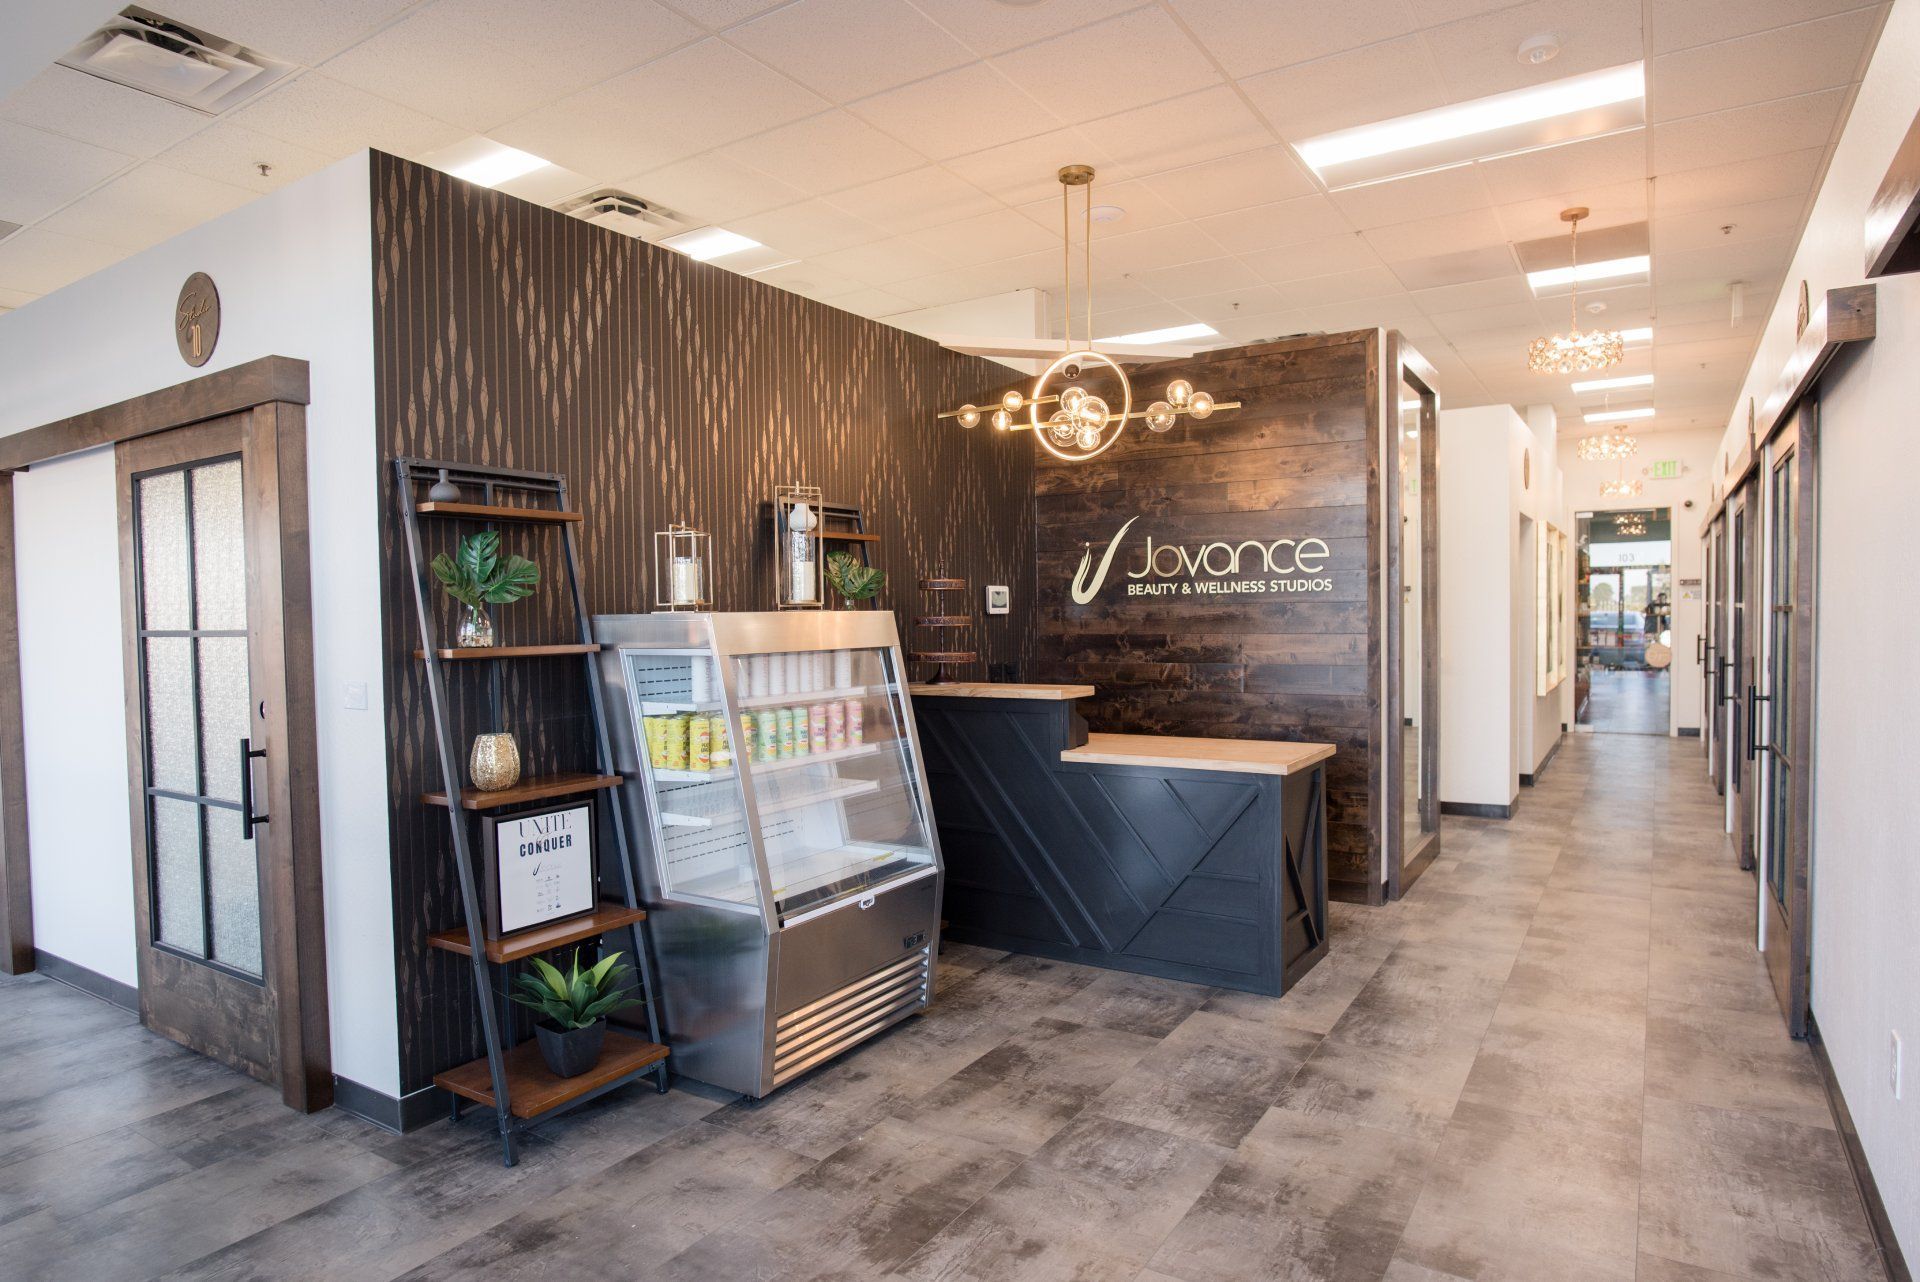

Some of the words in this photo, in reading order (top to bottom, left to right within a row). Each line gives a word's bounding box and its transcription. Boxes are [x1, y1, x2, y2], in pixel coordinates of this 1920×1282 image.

[191, 324, 203, 358] 10
[1653, 460, 1678, 477] EXIT
[1127, 535, 1330, 579] Jovance
[1127, 583, 1178, 596] BEAUTY
[1181, 583, 1192, 595] &
[1194, 580, 1266, 595] WELLNESS
[1269, 578, 1333, 593] STUDIOS
[519, 812, 572, 838] UNITE
[519, 834, 572, 857] CONQUER
